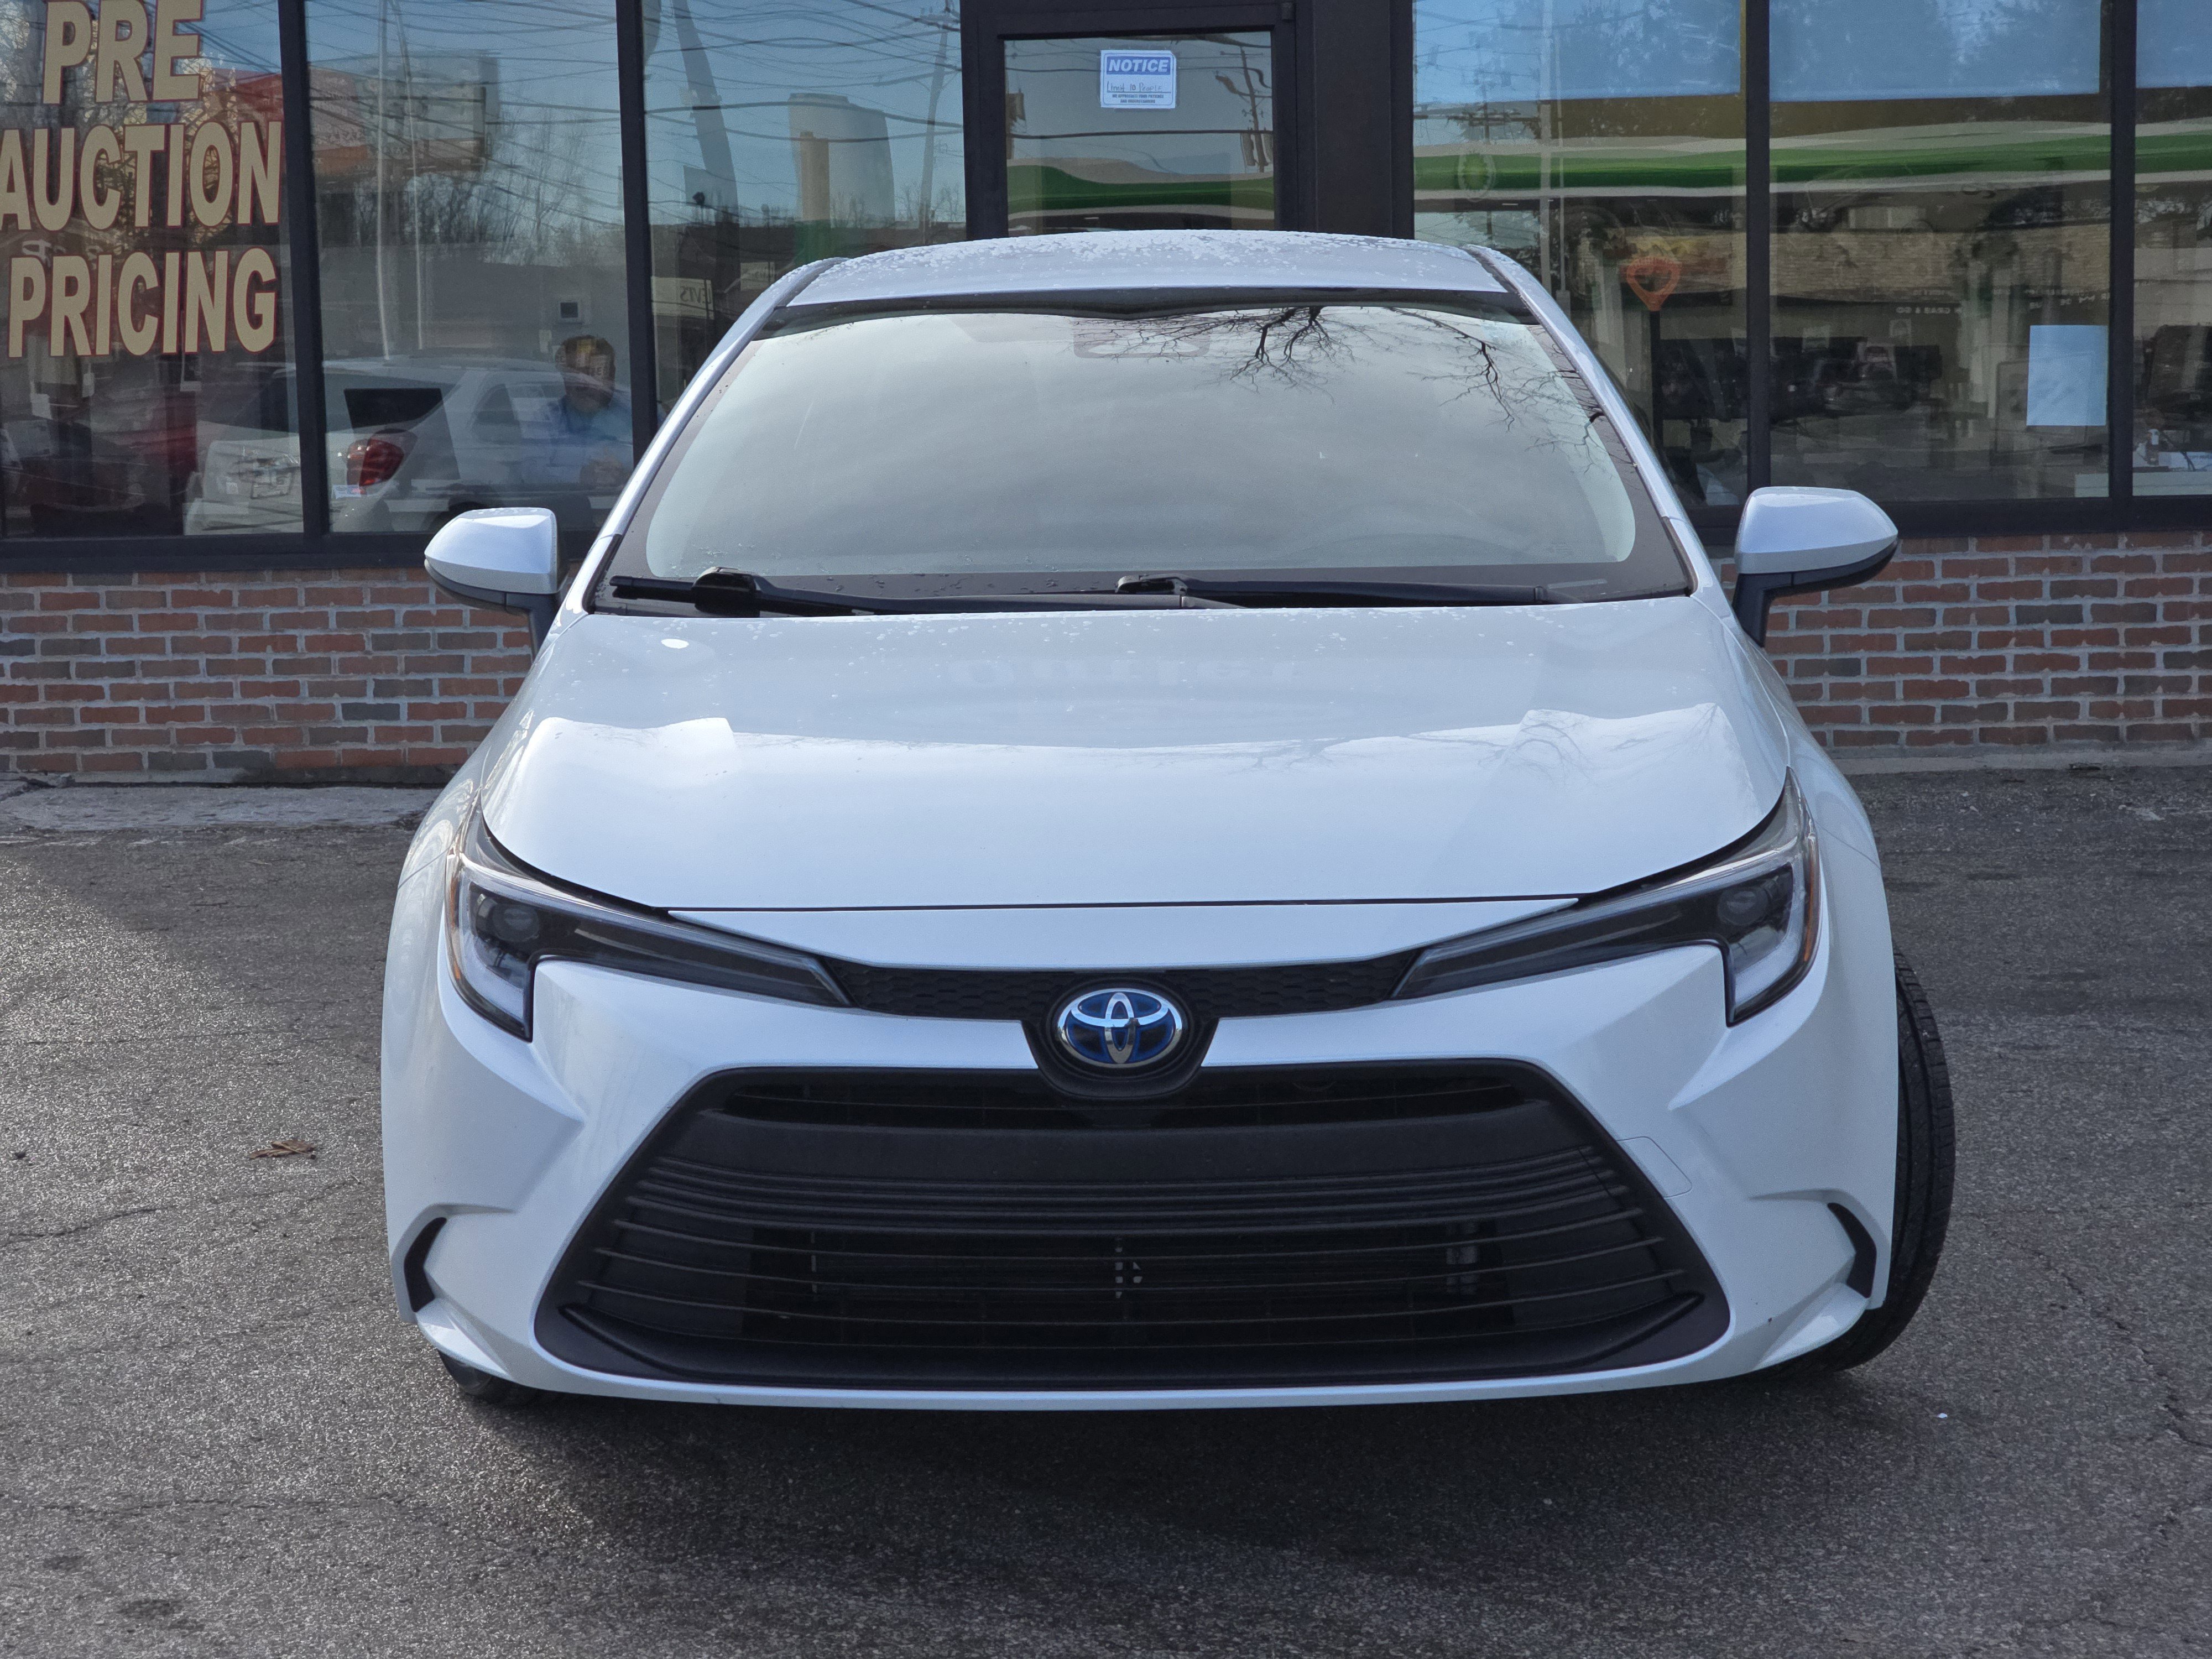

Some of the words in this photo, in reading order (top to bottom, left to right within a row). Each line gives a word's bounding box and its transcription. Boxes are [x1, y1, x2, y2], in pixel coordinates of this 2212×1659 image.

[42, 0, 204, 104] PRE
[1108, 59, 1169, 72] NOTICE
[0, 121, 283, 231] AUCTION
[8, 247, 278, 358] PRICING
